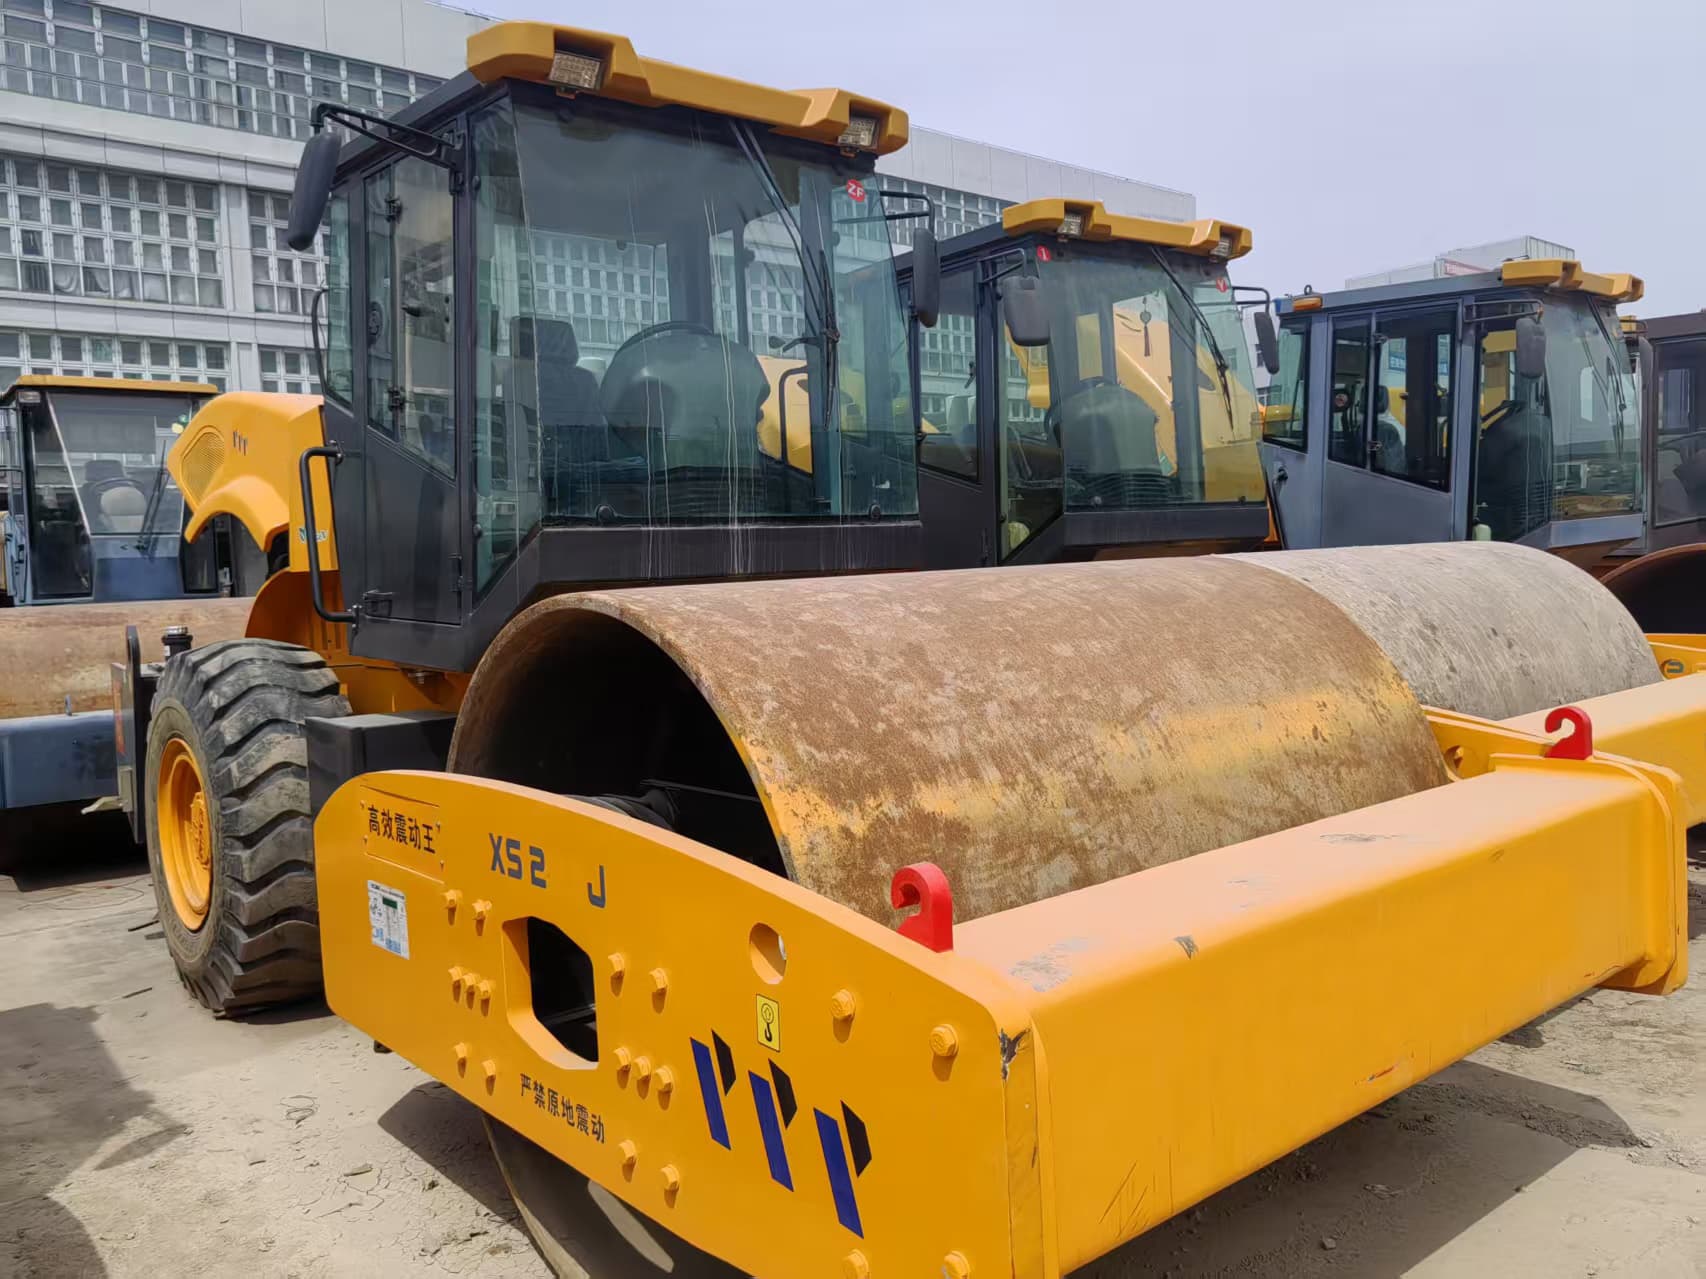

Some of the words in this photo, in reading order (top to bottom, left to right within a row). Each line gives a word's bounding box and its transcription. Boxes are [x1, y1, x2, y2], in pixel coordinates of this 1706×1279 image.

[368, 804, 436, 854] 高效震动王
[488, 832, 547, 889] XS2
[587, 864, 606, 908] J
[520, 1073, 605, 1144] 严禁原地震动
